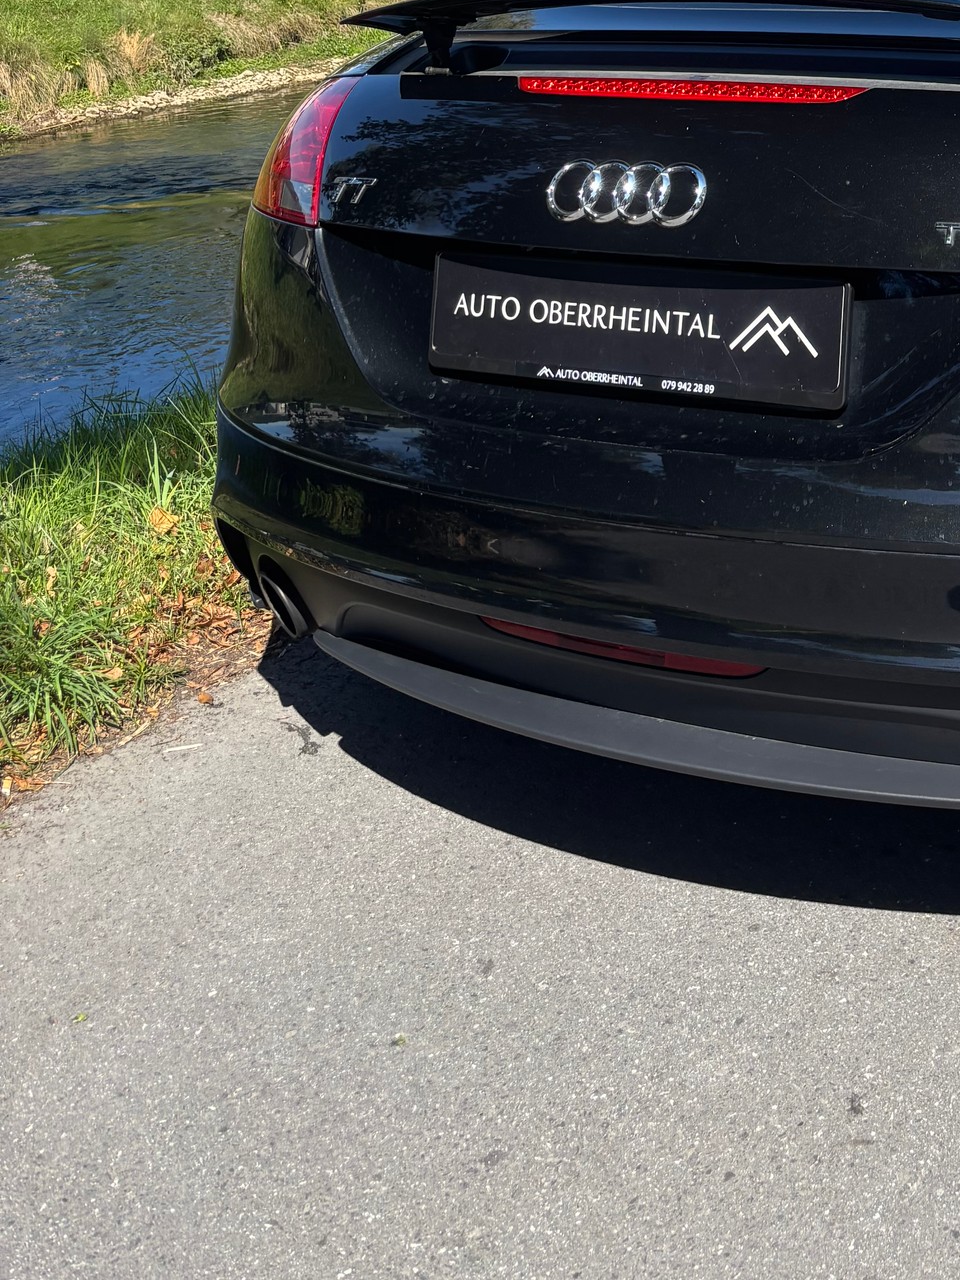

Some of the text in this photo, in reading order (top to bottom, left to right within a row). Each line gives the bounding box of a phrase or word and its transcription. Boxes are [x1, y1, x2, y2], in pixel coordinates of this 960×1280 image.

[325, 176, 376, 204] TT
[453, 292, 721, 340] AUTO OBERRHEINTAL
[555, 368, 715, 394] AUTO OBERRHEINTAL 079 942 28 89
